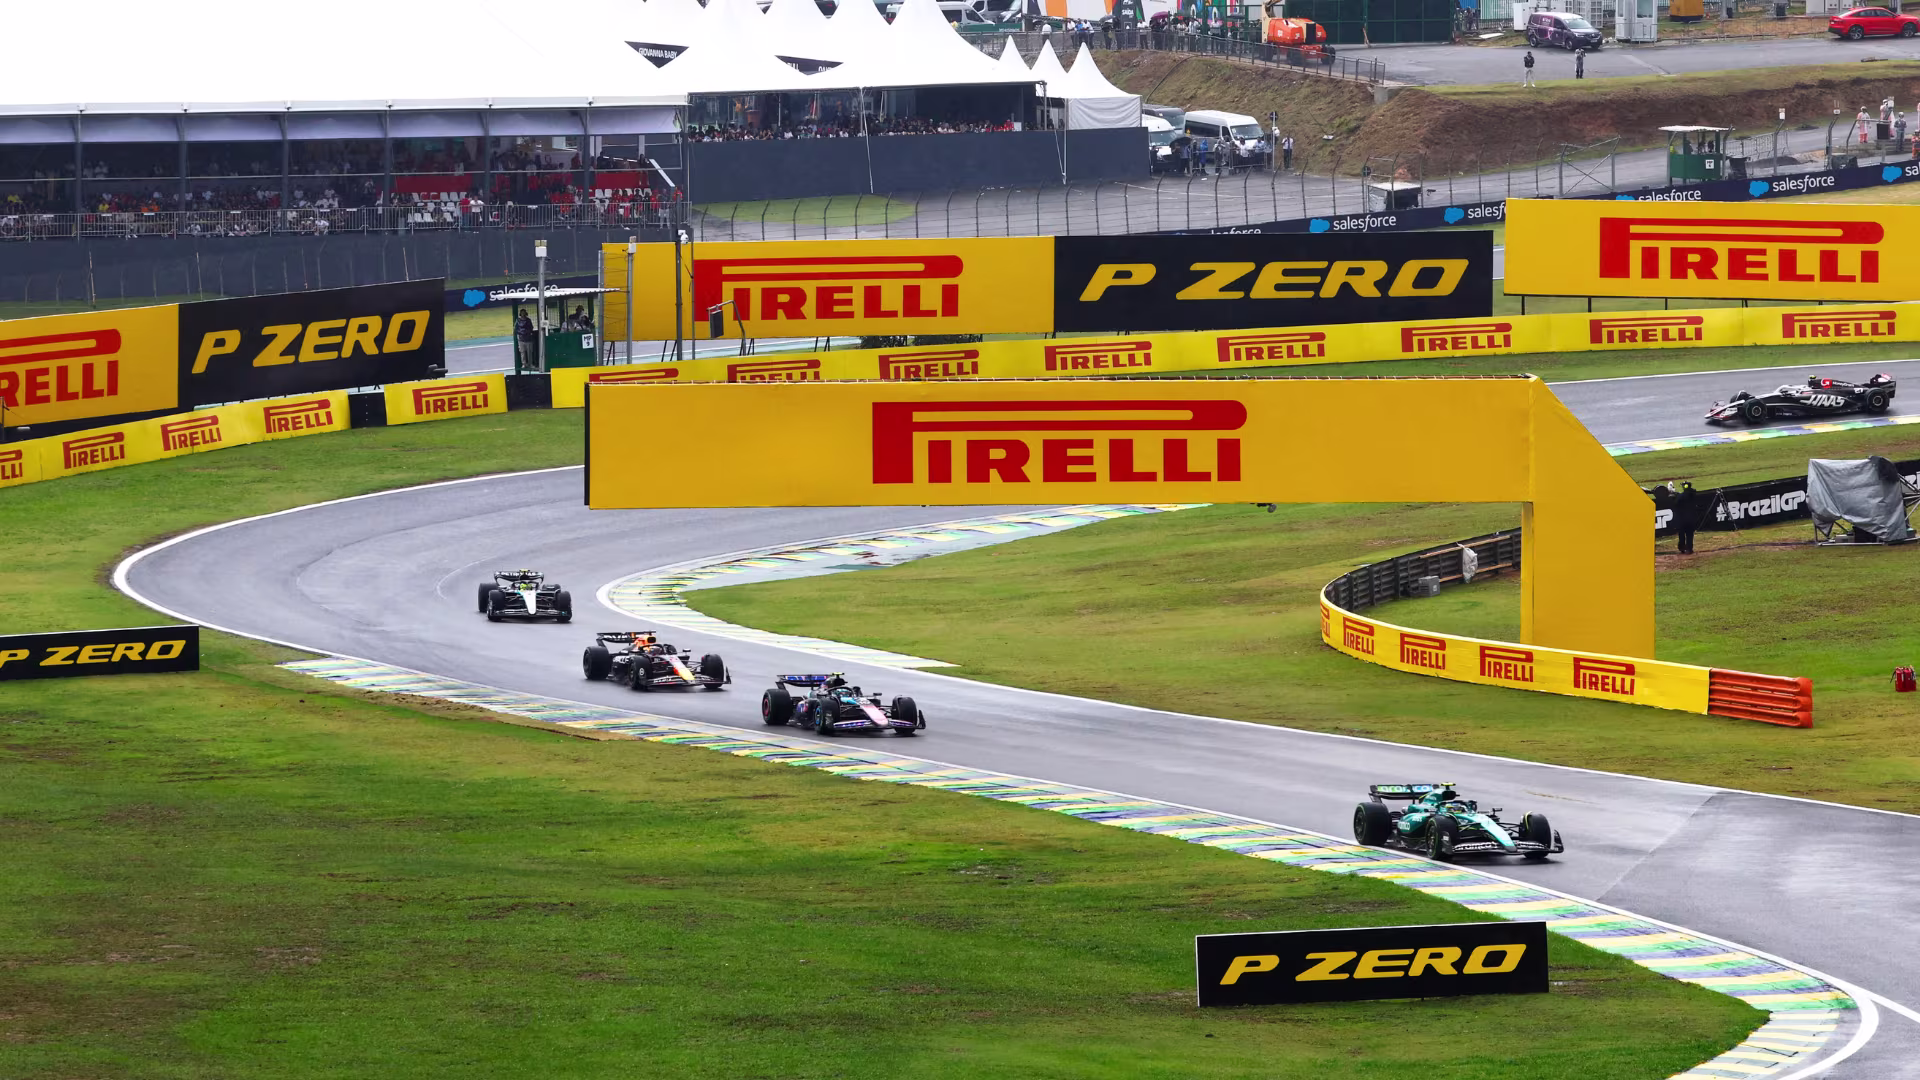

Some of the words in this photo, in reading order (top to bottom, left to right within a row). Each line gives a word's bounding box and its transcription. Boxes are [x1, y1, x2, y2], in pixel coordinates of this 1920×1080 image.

[1772, 175, 1835, 192] salesforce
[1333, 214, 1397, 232] salesforce
[1467, 202, 1506, 219] salesf
[1600, 217, 1885, 283] PIRELLI
[692, 255, 964, 322] PIRELLI
[1080, 263, 1157, 302] P
[1175, 259, 1469, 300] ZERO
[1401, 323, 1512, 352] PIRELLI
[1589, 316, 1704, 344] PIRELLI
[1782, 311, 1897, 339] PIRELLI
[192, 329, 242, 374] P
[252, 310, 431, 367] ZERO
[1044, 341, 1152, 370] PIRELLI
[1217, 332, 1326, 362] PIRELLI
[878, 350, 979, 379] PIRELLI
[412, 382, 488, 415] PIRELLI
[1800, 394, 1845, 407] HAAS
[263, 399, 333, 433] PIRELLI
[161, 415, 222, 451] PIRELLI
[872, 400, 1247, 484] PIRELLI
[63, 432, 125, 469] PIRELLI
[1716, 490, 1806, 522] #BrazilGP
[1343, 616, 1374, 655] PIRELLI
[1400, 633, 1446, 670] PIRELLI
[0, 649, 30, 668] P
[39, 640, 186, 666] ZERO
[1480, 646, 1533, 682] PIRELLI
[1573, 657, 1635, 695] PIRELLI
[1219, 954, 1280, 985] P
[1295, 944, 1527, 982] ZERO
